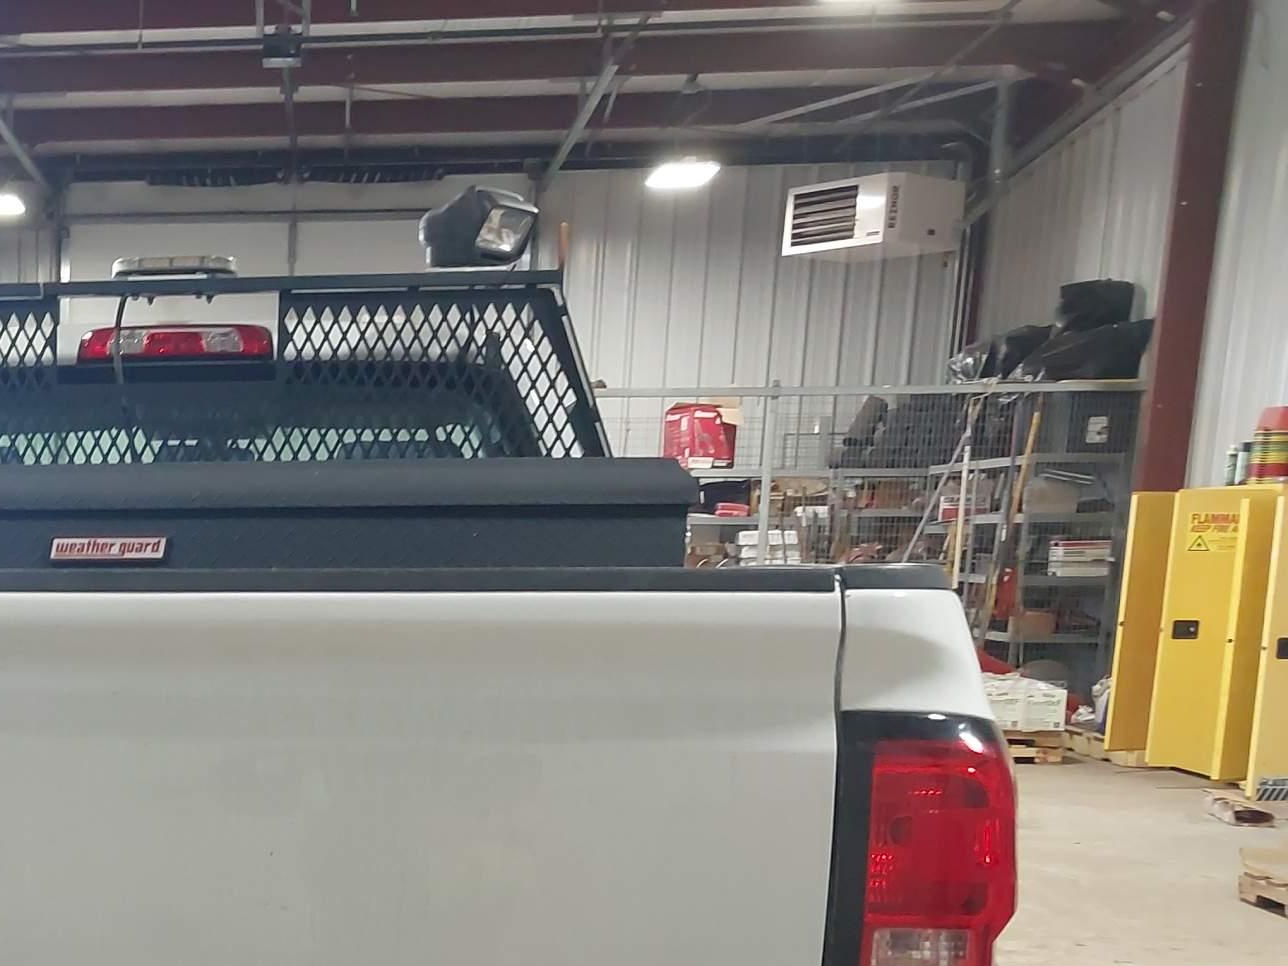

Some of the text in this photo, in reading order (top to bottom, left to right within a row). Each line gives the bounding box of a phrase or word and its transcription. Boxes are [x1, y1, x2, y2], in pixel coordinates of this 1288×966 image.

[1191, 512, 1240, 524] FLAMMA
[55, 538, 162, 557] weather guard
